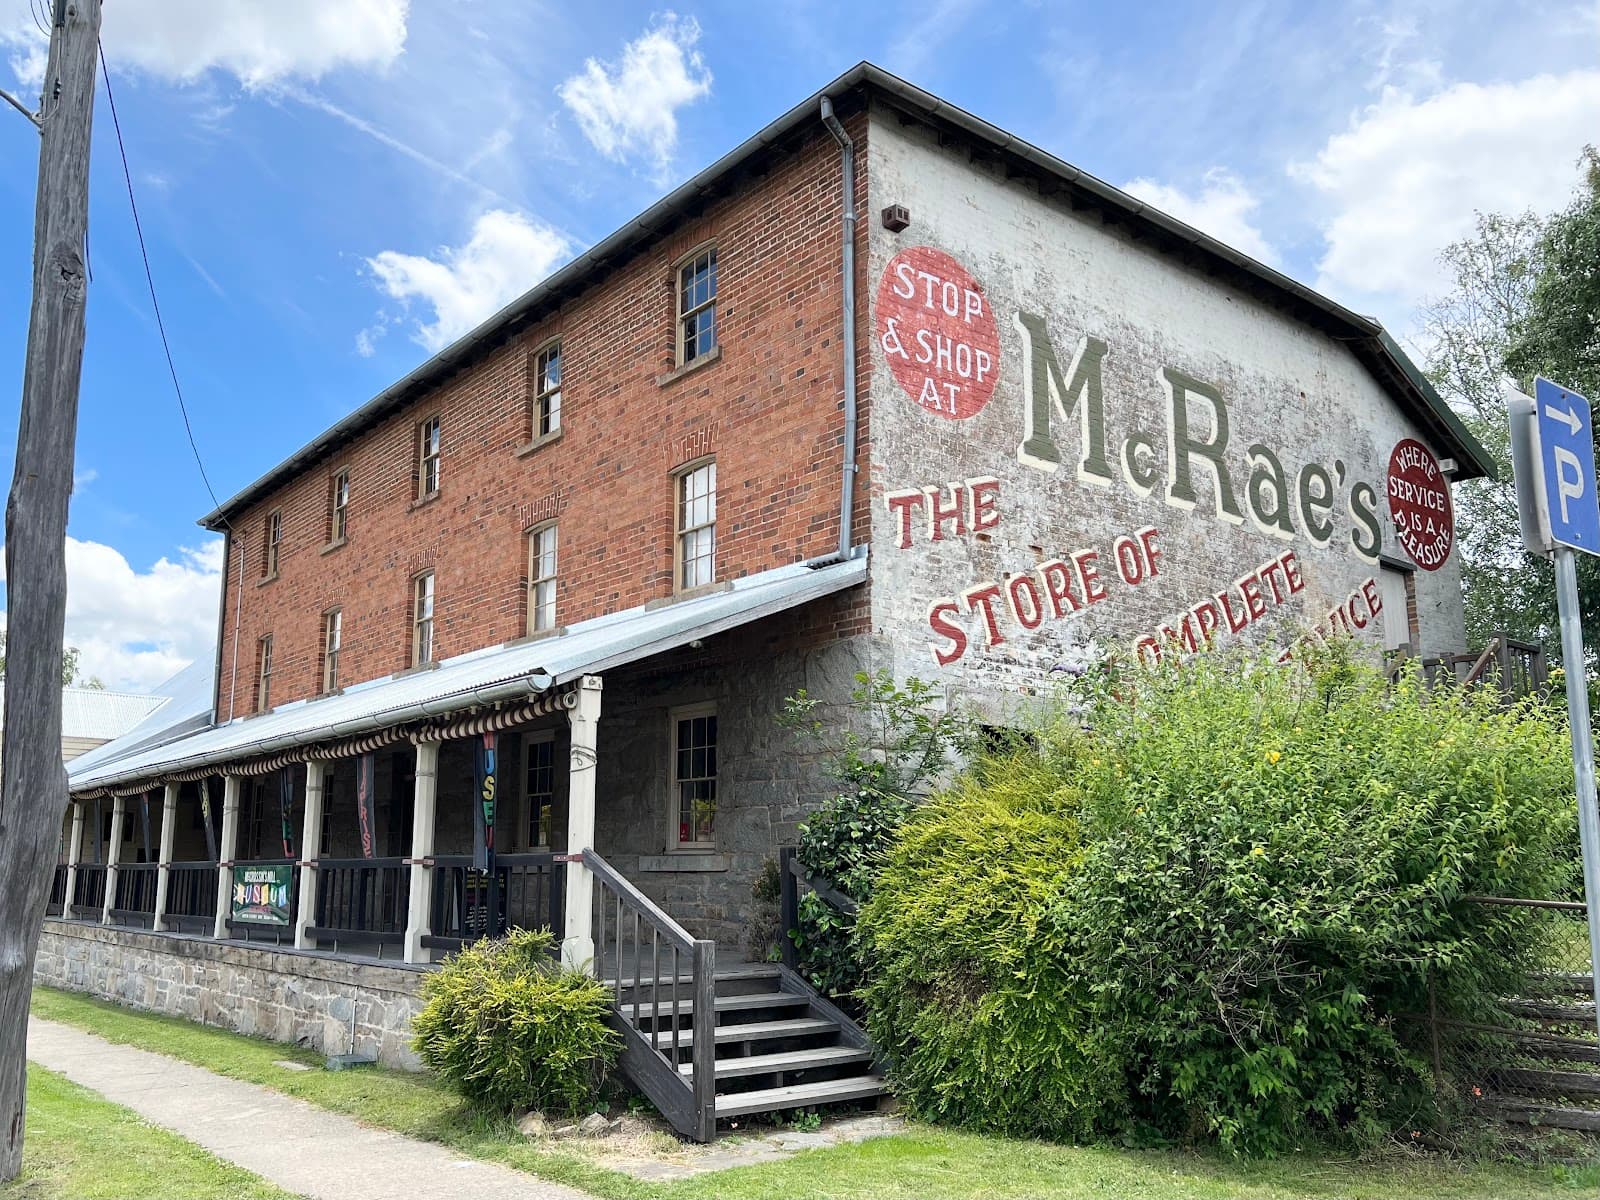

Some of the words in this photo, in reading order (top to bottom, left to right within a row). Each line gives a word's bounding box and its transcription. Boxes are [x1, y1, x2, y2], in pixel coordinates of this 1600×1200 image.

[893, 262, 984, 324] STOP
[881, 315, 909, 360] &
[915, 328, 991, 383] SHOP
[918, 376, 961, 416] AT
[1012, 310, 1382, 566] McRae's
[1395, 445, 1437, 483] WHERE
[884, 475, 1001, 549] THE
[1389, 475, 1446, 513] SERVICE
[1553, 445, 1585, 524] P
[1394, 508, 1451, 566] PLEASURE
[1410, 511, 1423, 532] IS
[1425, 516, 1438, 537] A
[927, 547, 1108, 668] STORE
[1113, 524, 1163, 586] OF
[1132, 549, 1305, 668] OMPLETE
